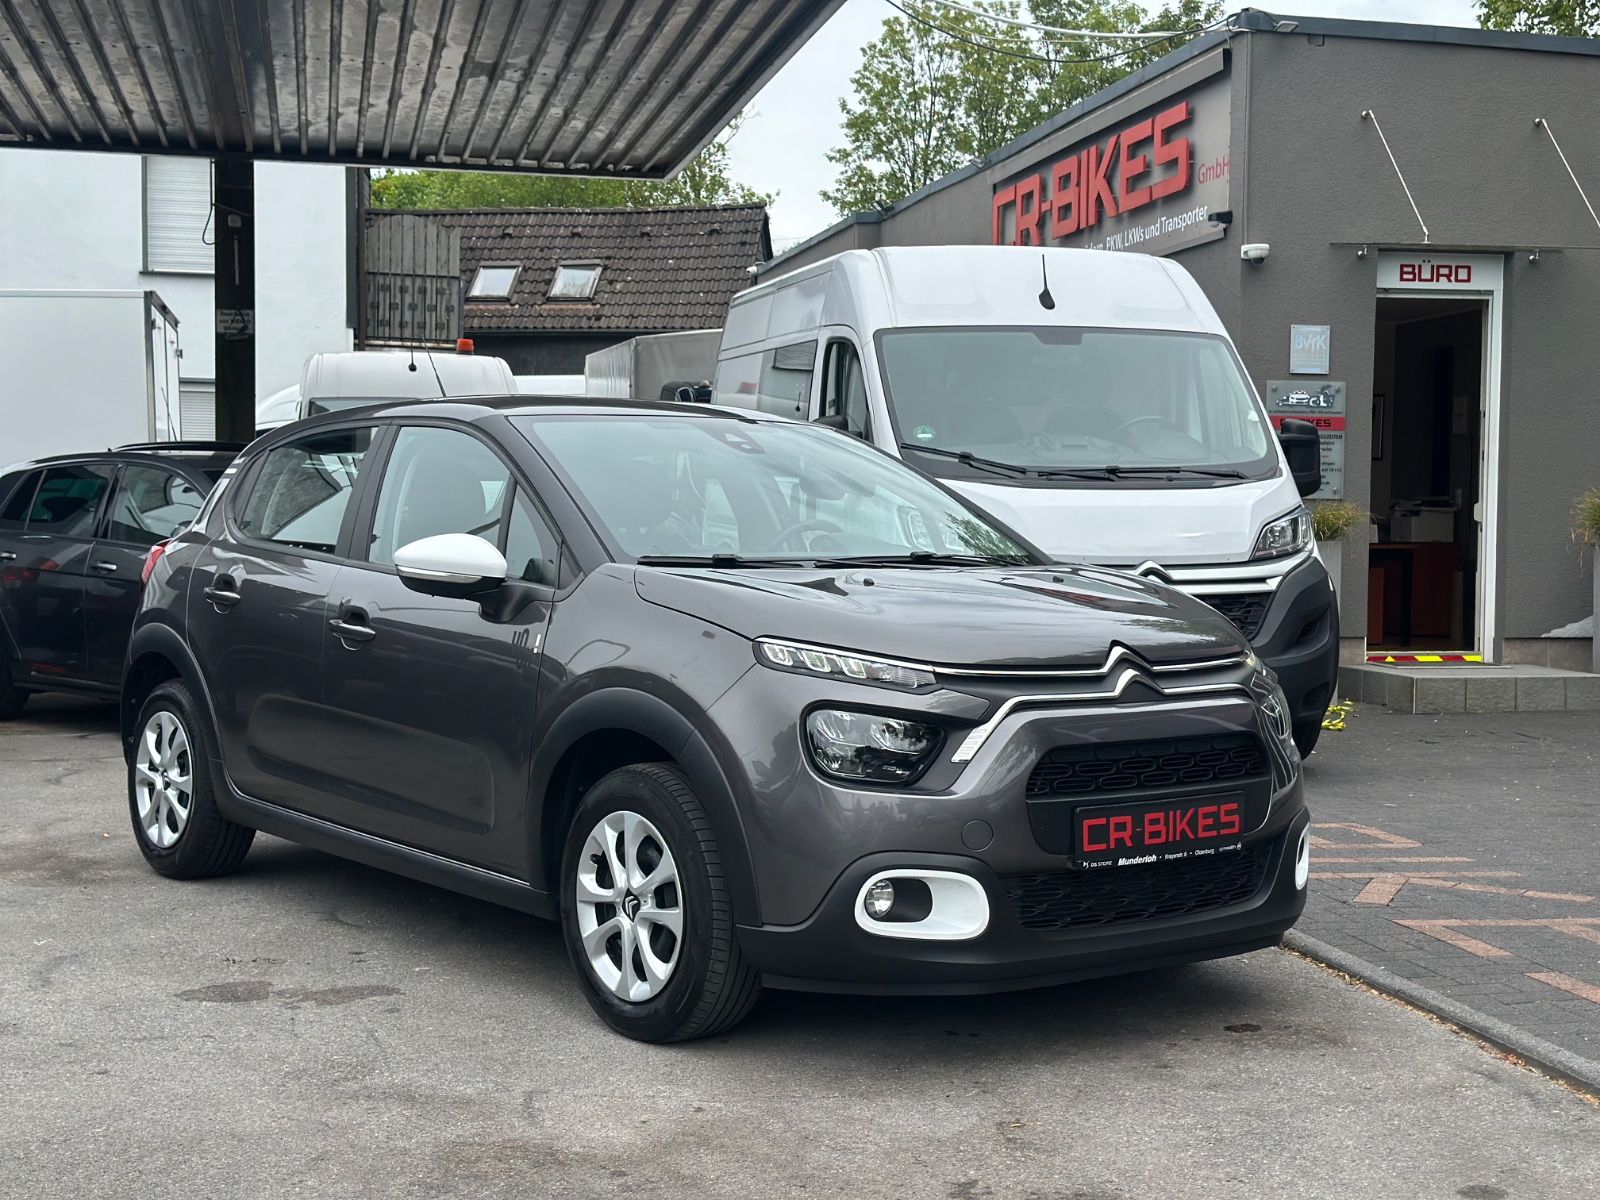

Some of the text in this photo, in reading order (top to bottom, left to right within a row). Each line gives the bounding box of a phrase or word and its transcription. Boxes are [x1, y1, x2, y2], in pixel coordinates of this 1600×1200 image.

[992, 101, 1189, 246] CR-BIKES
[1198, 155, 1231, 184] GmbH
[1124, 225, 1144, 247] LKWs
[1145, 218, 1160, 240] und
[1160, 205, 1208, 234] Transporter
[1399, 259, 1472, 283] BÜRO
[1082, 803, 1240, 852] CR-BIKES
[1117, 853, 1157, 866] Munderloh
